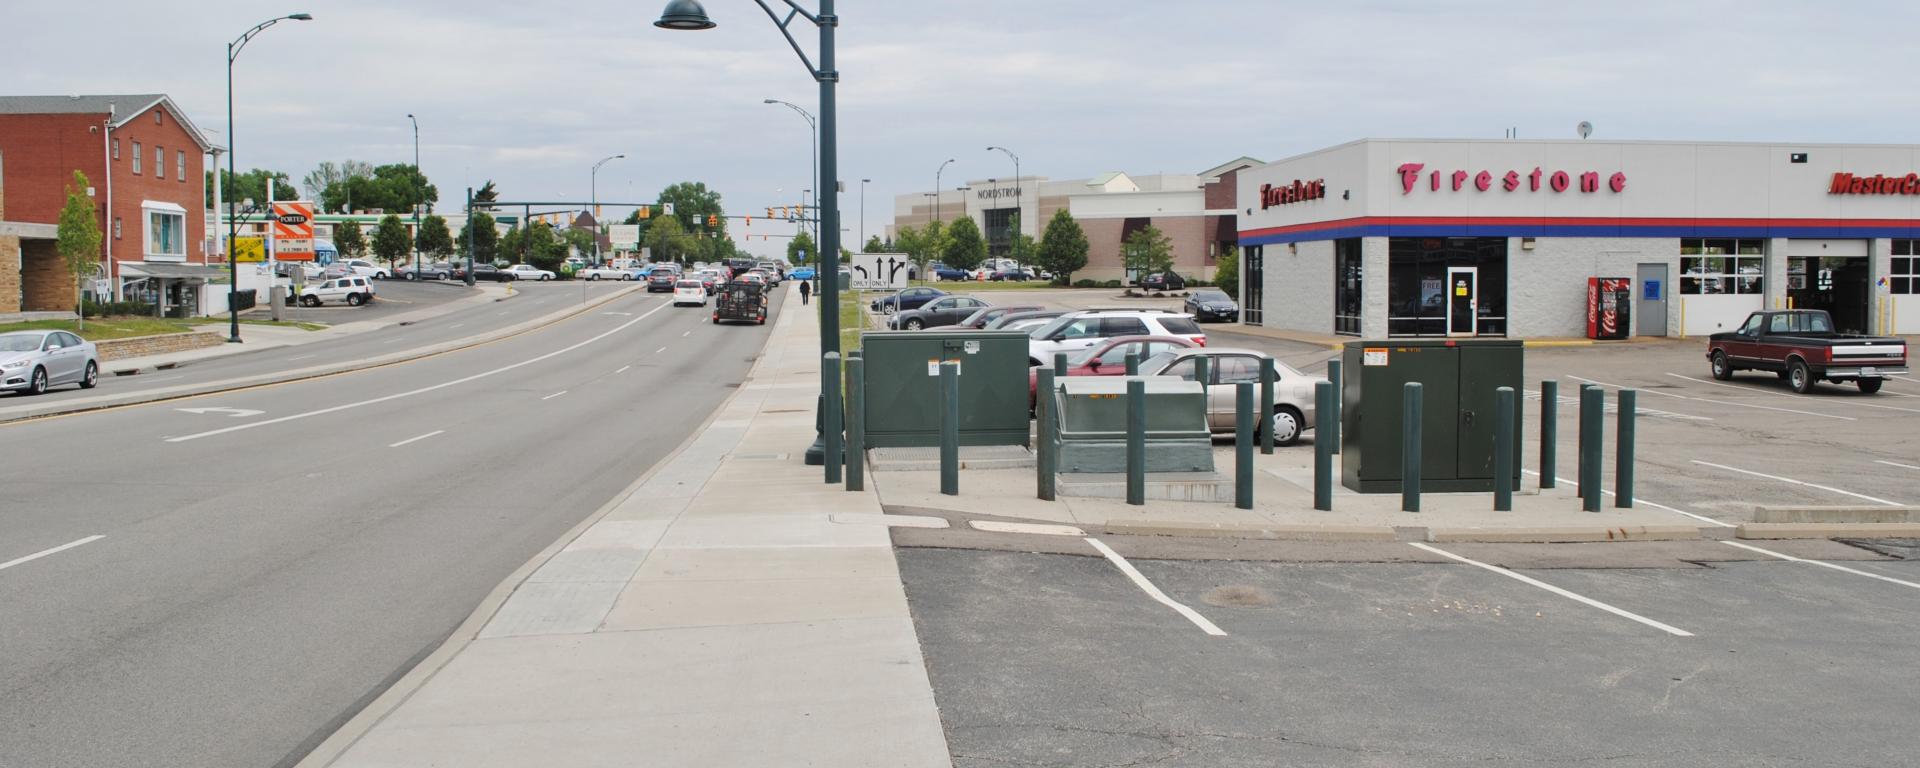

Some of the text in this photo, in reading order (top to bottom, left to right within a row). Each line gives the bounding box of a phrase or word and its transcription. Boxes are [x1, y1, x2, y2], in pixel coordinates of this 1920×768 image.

[1397, 163, 1627, 195] Firestone
[977, 187, 1022, 199] NORDSTROM
[280, 215, 305, 223] PORTER
[1422, 282, 1440, 290] FREE
